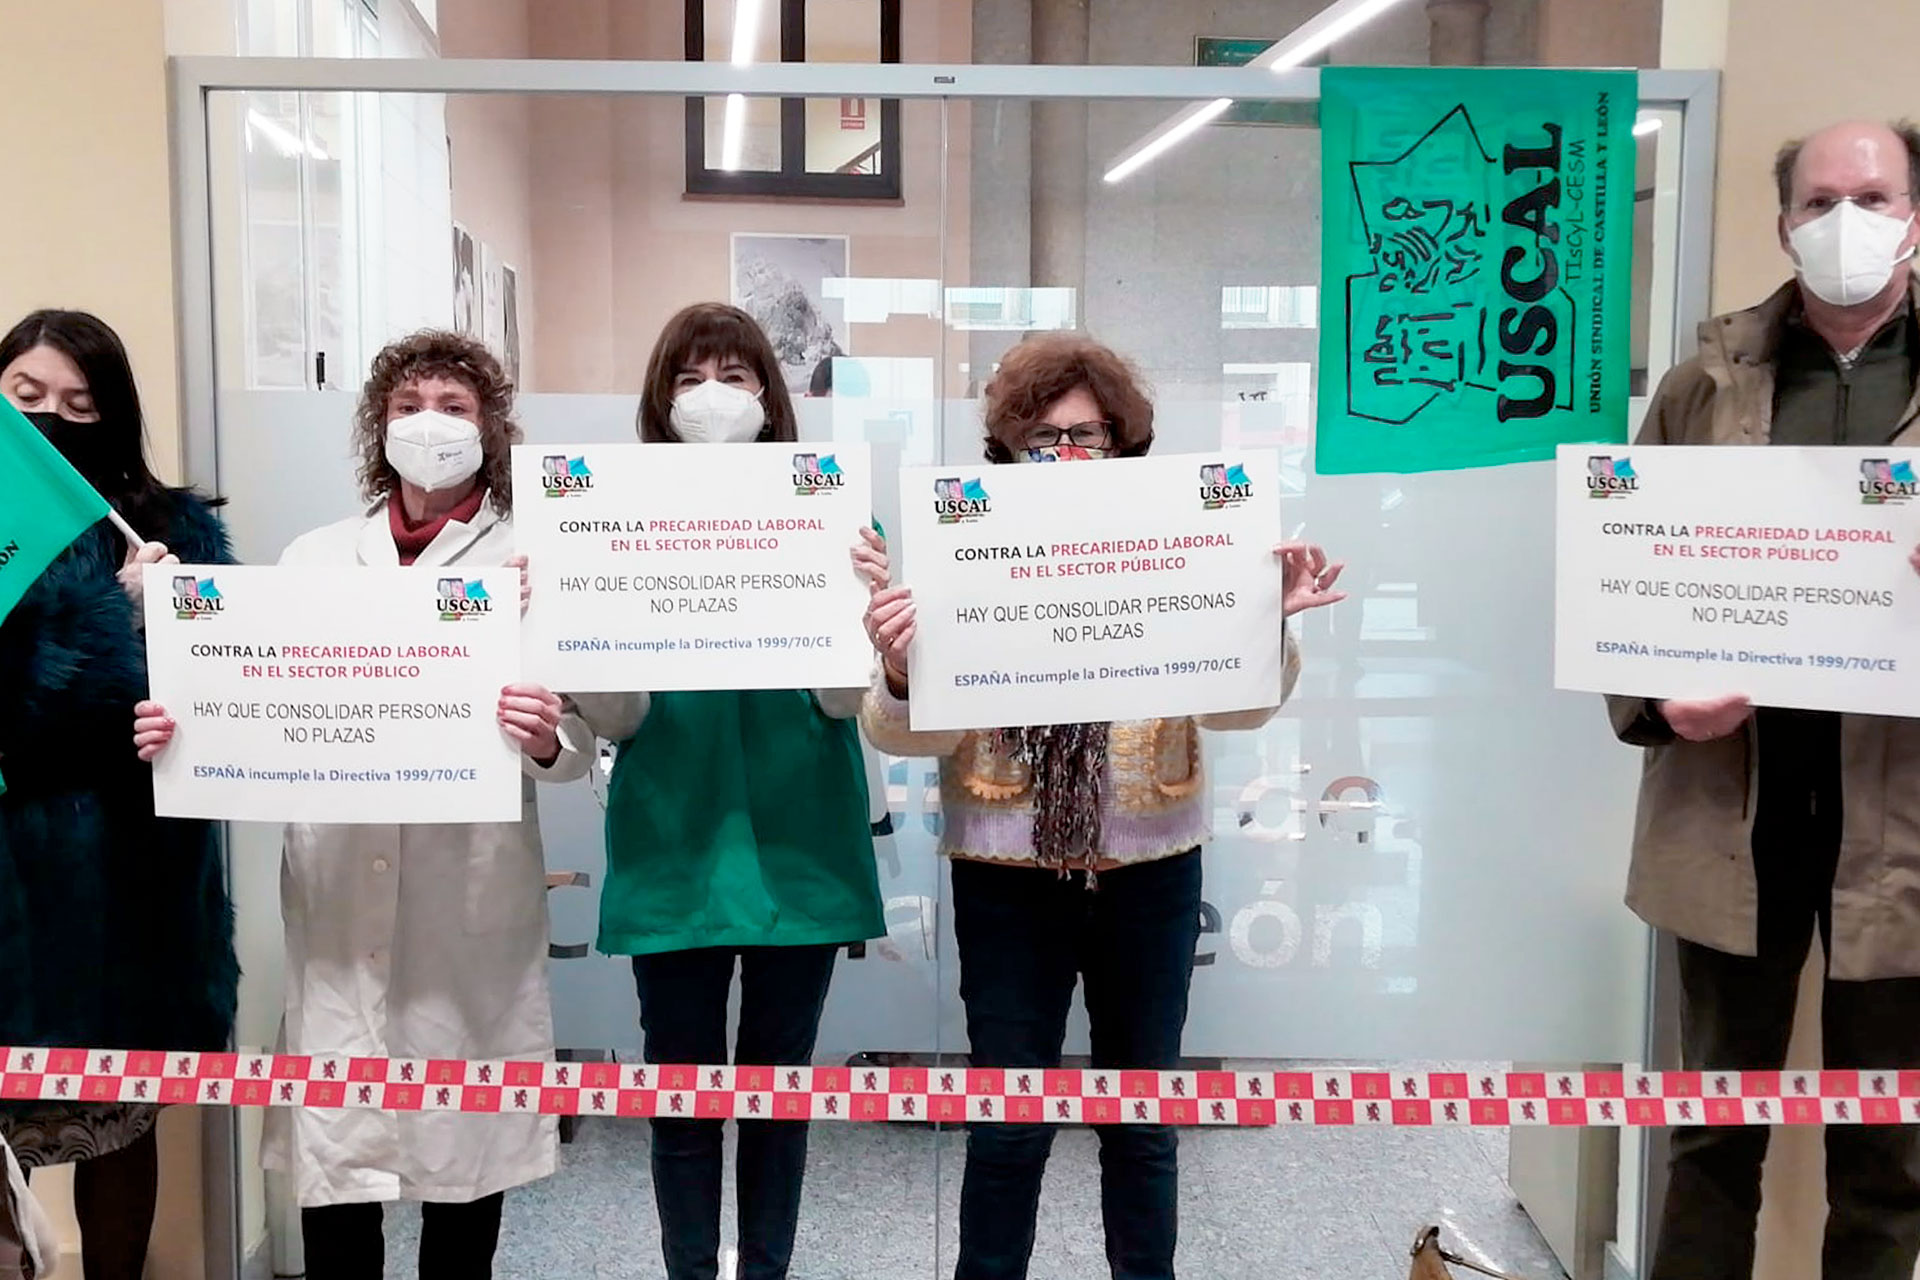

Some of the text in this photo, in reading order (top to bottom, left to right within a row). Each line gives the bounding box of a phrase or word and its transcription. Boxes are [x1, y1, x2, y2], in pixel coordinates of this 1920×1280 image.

[1588, 91, 1609, 413] UNIÓN SINDICAL DE CASTILLA Y LEÓN
[1497, 122, 1561, 423] USCAL
[542, 475, 594, 489] USCAL
[792, 474, 845, 488] USCAL
[1586, 476, 1639, 490] USCAL
[1859, 481, 1920, 496] USCAL
[1199, 484, 1254, 500] USCAL
[934, 499, 991, 515] USCAL
[560, 519, 824, 532] CONTRA LA PRECARIEDAD LABORAL
[1603, 523, 1894, 543] CONTRA LA PRECARIEDAD LABORAL
[612, 536, 778, 551] EN EL SECTOR PÚBLICO
[955, 534, 1233, 561] CONTRA LA PRECARIEDAD LABORAL
[1654, 544, 1838, 561] EN EL SECTOR PÚBLICO
[1011, 557, 1185, 578] EN EL SECTOR PÚBLICO
[561, 574, 826, 591] HAY QUE CONSOLIDAR PERSONAS
[1601, 579, 1893, 607] HAY QUE CONSOLIDAR PERSONAS
[172, 596, 225, 612] USCAL
[435, 598, 493, 613] USCAL
[651, 598, 737, 613] NO PLAZAS
[957, 592, 1235, 623] HAY QUE CONSOLIDAR PERSONAS
[1693, 607, 1788, 626] NO PLAZAS
[1054, 623, 1143, 642] NO PLAZAS
[191, 645, 469, 658] CONTRA LA PRECARIEDAD LABORAL
[558, 637, 831, 653] ESPAÑA incumple la Directiva 1999/70/CE
[1596, 642, 1896, 671] ESPAÑA incumple la Directiva 1999/70/CE
[243, 663, 420, 678] EN EL SECTOR PÚBLICO
[955, 658, 1240, 686] ESPAÑA incumple la Directiva 1999/70/CE
[194, 702, 470, 720] HAY QUE CONSOLIDAR PERSONAS
[284, 728, 375, 743] NO PLAZAS
[194, 765, 476, 783] ESPAÑA incumple la Directiva 1999/70/CE
